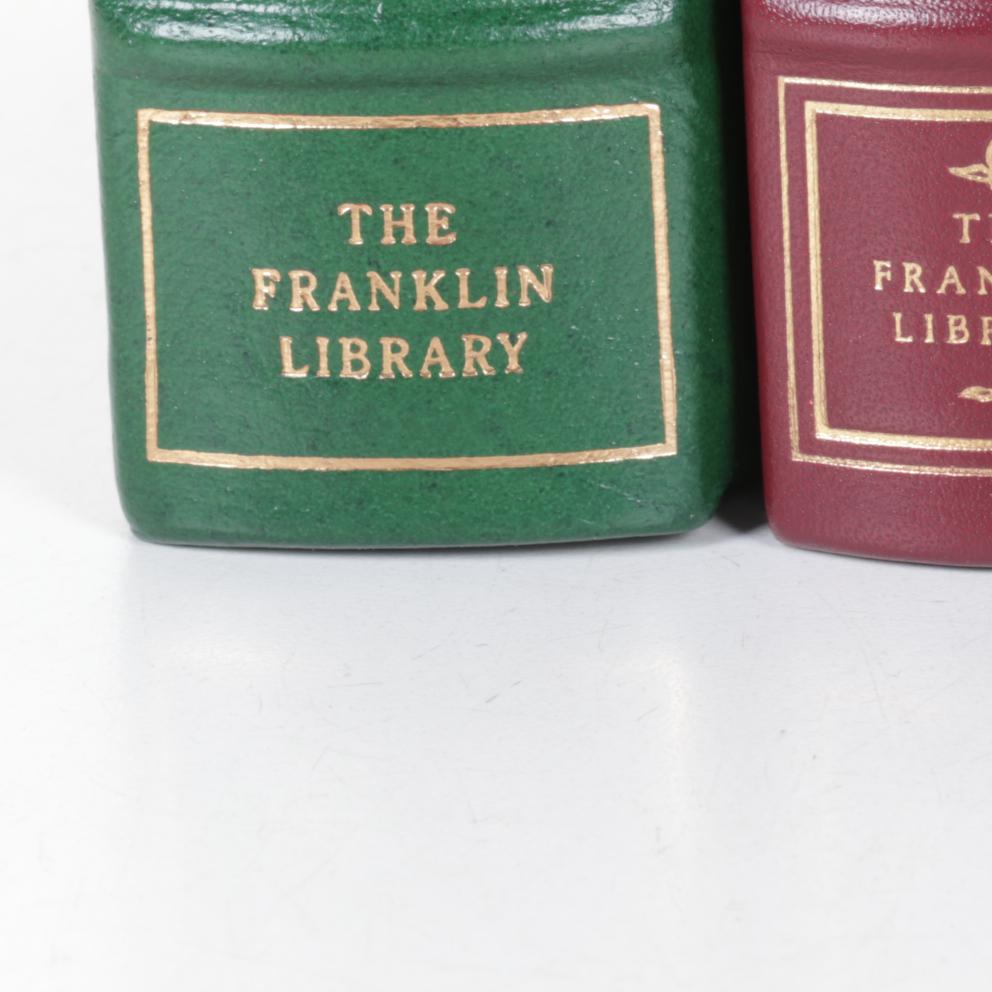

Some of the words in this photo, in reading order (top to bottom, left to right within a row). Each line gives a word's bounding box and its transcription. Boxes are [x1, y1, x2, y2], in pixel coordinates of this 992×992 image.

[338, 202, 456, 245] THE
[251, 264, 553, 312] FRANKLIN
[279, 331, 527, 379] LIBRARY
